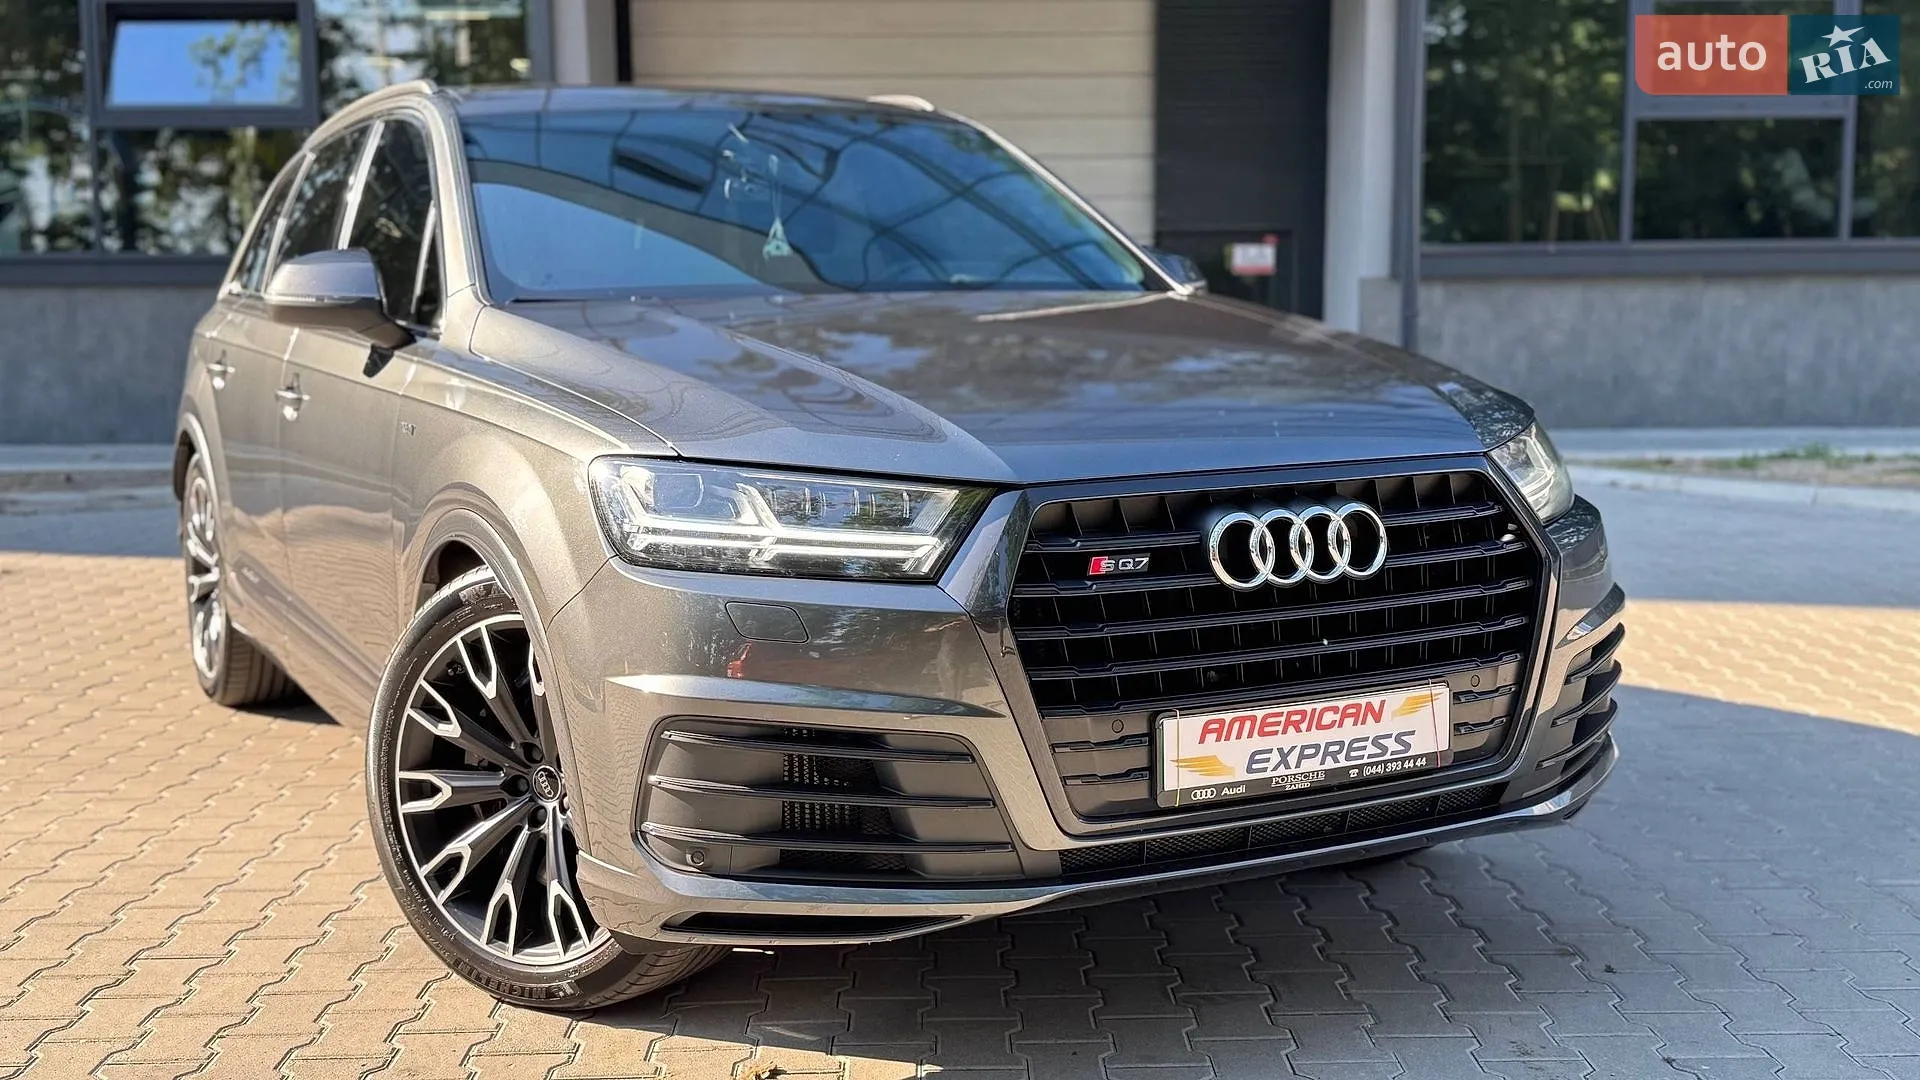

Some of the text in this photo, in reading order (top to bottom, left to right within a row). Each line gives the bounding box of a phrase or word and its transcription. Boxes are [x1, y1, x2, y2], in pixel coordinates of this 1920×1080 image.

[1100, 557, 1149, 571] SQ7
[1198, 700, 1386, 744] AMERICAN
[1246, 730, 1416, 774] EXPRESS
[1363, 757, 1427, 777] (044) 393 44 44
[1271, 771, 1325, 785] PORSCHE
[1221, 785, 1246, 796] Audi
[454, 959, 547, 999] MICHELIN
